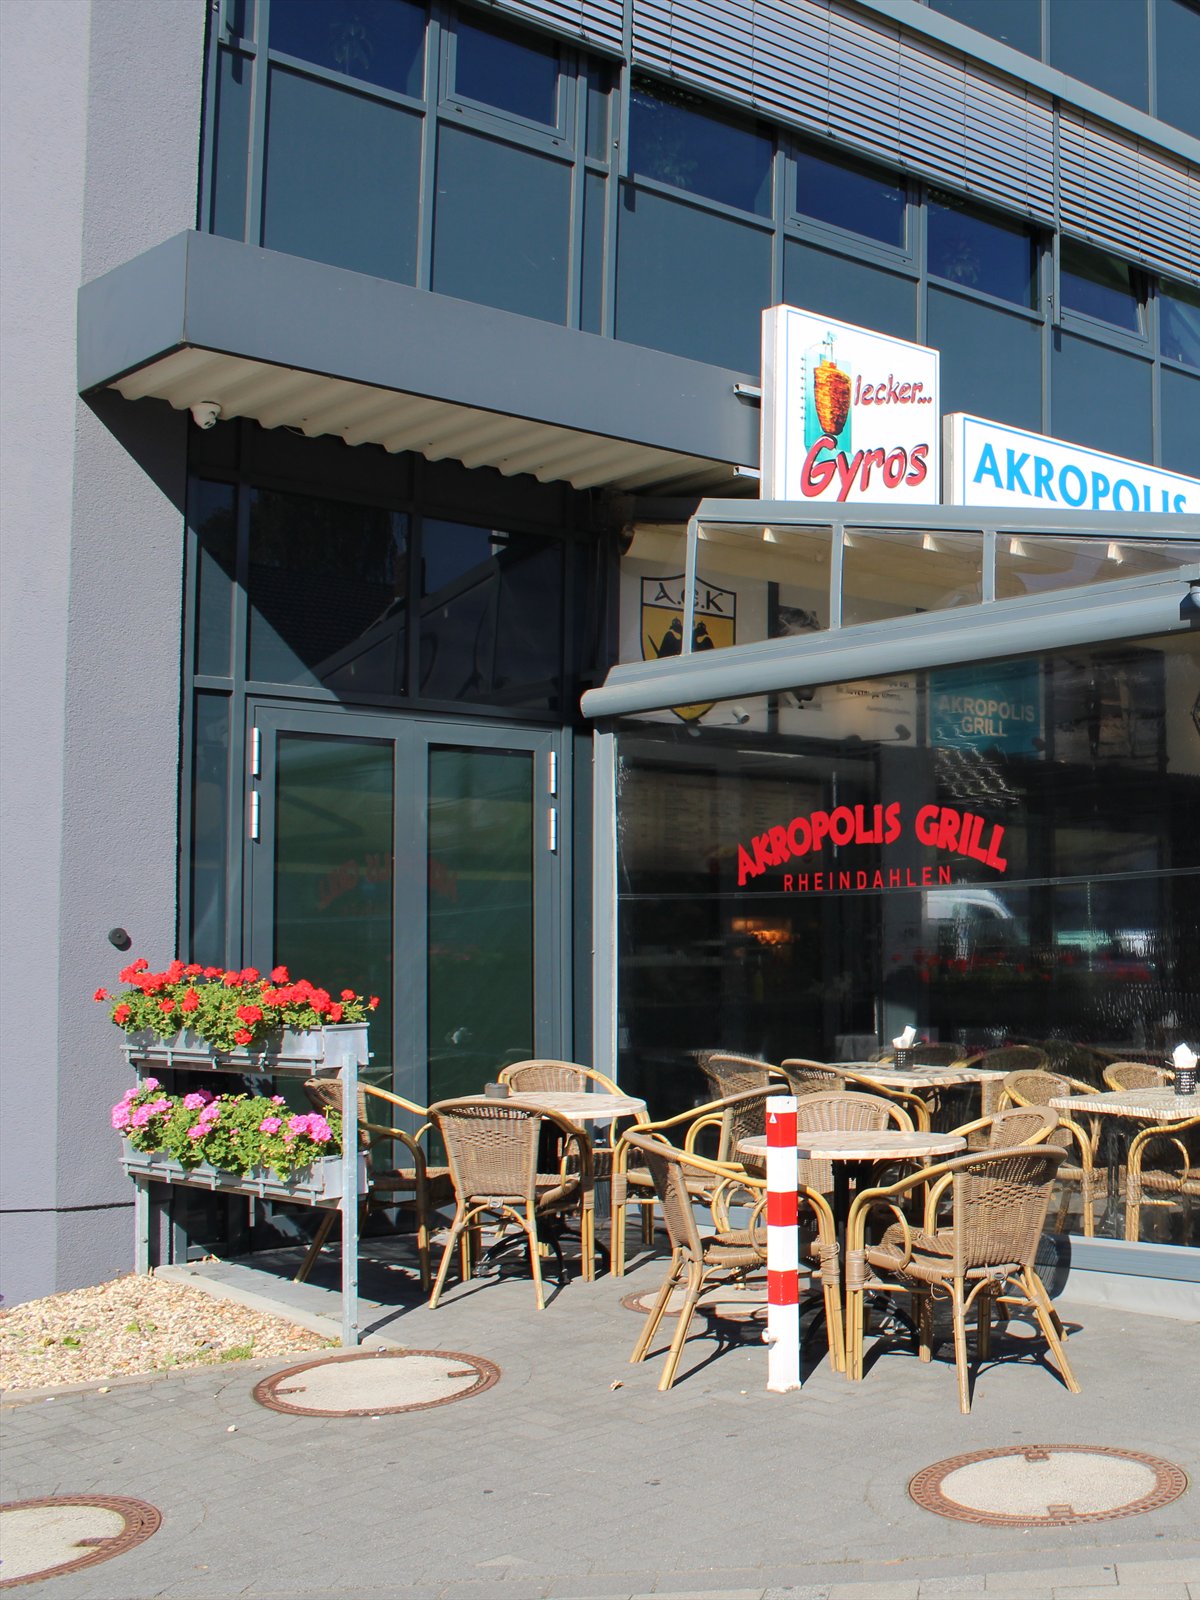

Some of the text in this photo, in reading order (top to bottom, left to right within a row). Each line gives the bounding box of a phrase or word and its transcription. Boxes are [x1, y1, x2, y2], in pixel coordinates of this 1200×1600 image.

[854, 374, 932, 406] lecker...
[801, 434, 929, 502] Gyros
[938, 696, 1035, 722] AKROPOLIS
[961, 716, 1008, 737] GRILL
[738, 801, 902, 886] AKROPOLIS
[915, 804, 1007, 873] GRILL
[784, 865, 951, 892] RHEINDAHLEN
